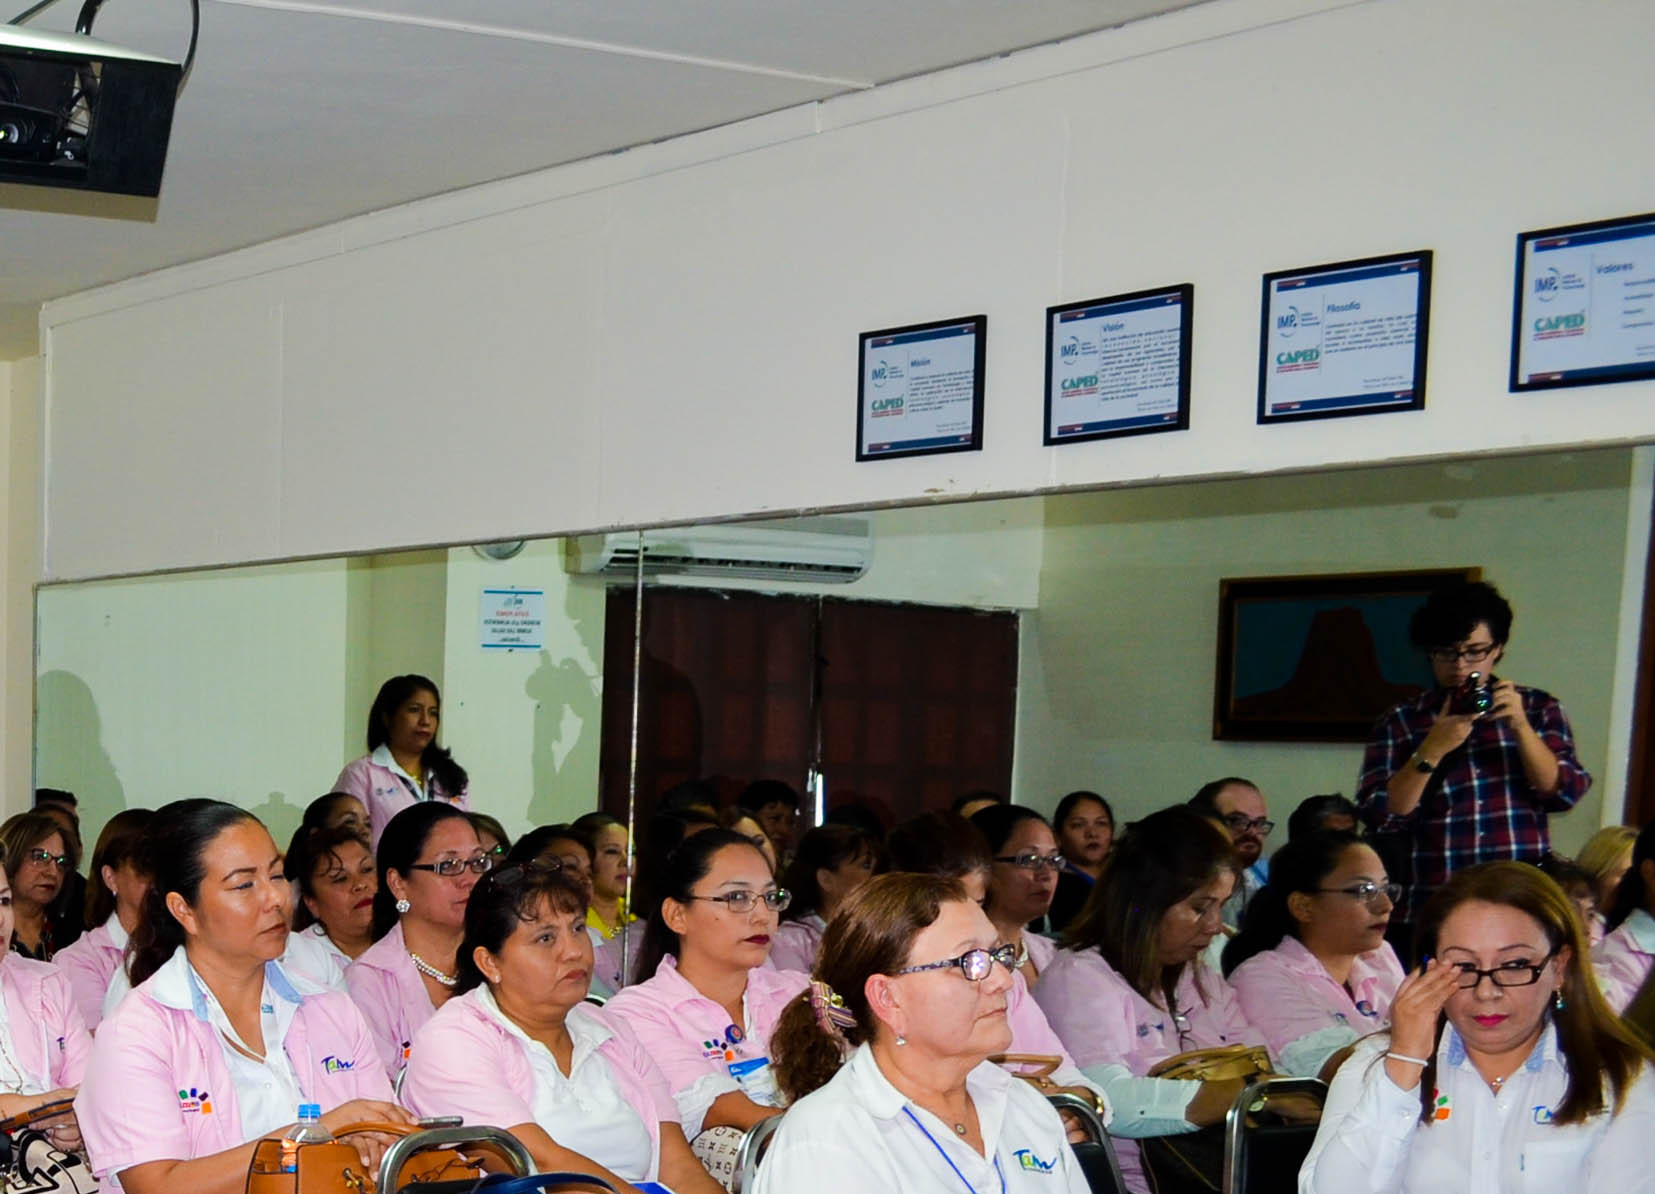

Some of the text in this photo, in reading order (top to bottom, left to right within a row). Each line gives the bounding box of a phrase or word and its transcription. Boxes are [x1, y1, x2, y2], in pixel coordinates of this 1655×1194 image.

[1595, 262, 1635, 275] Valores
[1534, 312, 1585, 332] CAPED
[1276, 348, 1320, 365] CAPED
[1060, 374, 1099, 391] CAPED
[871, 397, 904, 412] CAPED
